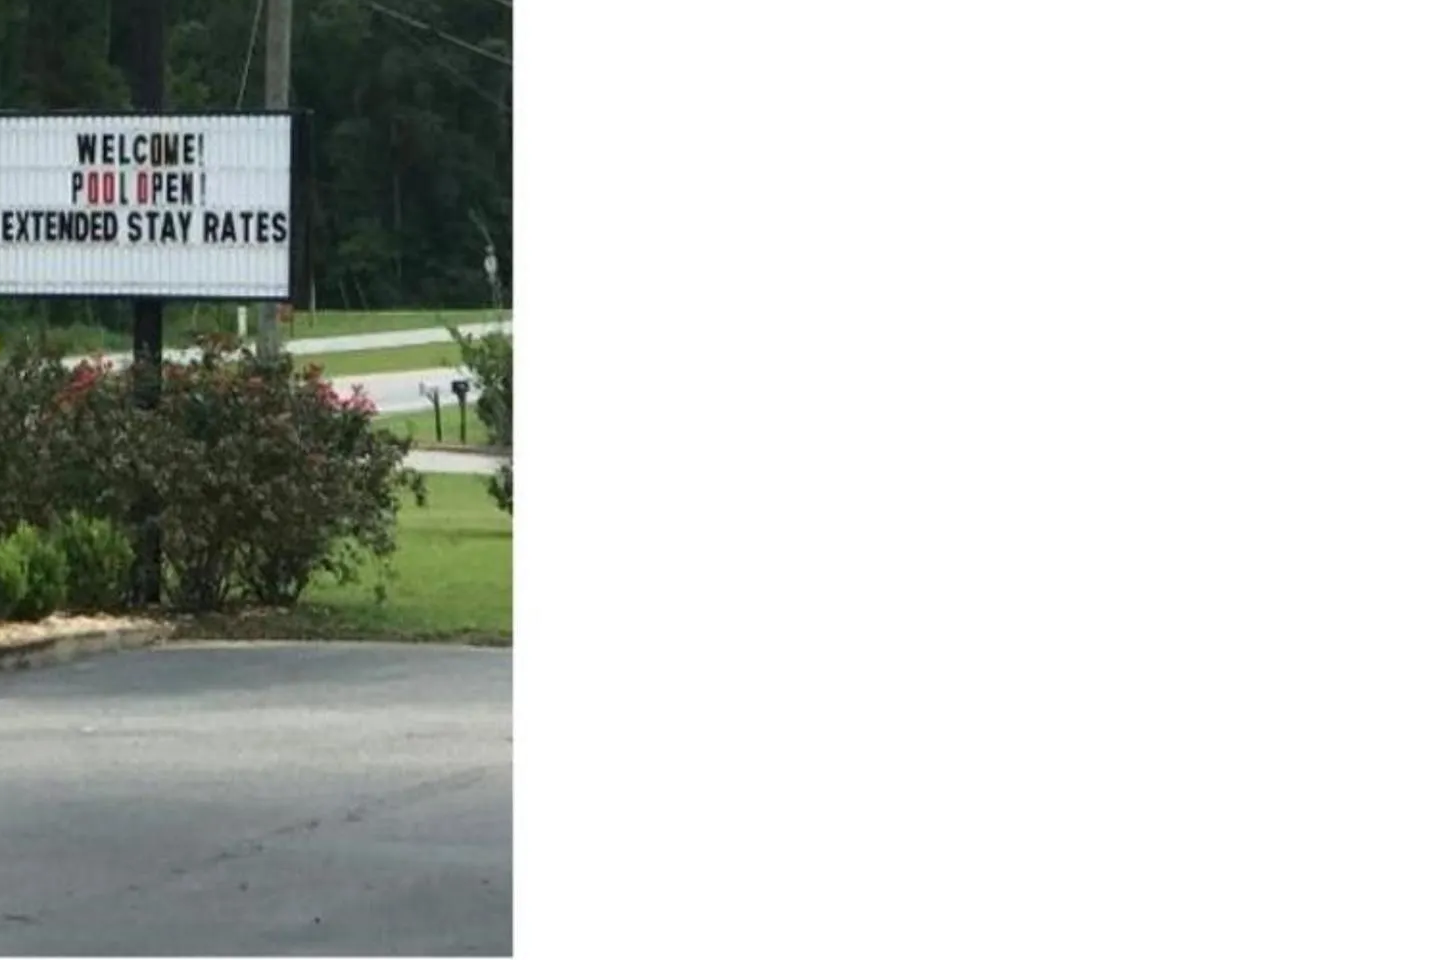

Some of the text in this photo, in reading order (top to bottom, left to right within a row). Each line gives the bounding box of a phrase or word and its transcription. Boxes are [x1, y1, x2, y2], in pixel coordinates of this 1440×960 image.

[76, 133, 205, 167] WELCOME!
[71, 171, 207, 206] POOL OPEN!
[1, 211, 288, 244] EXTENDED STAY RATES
